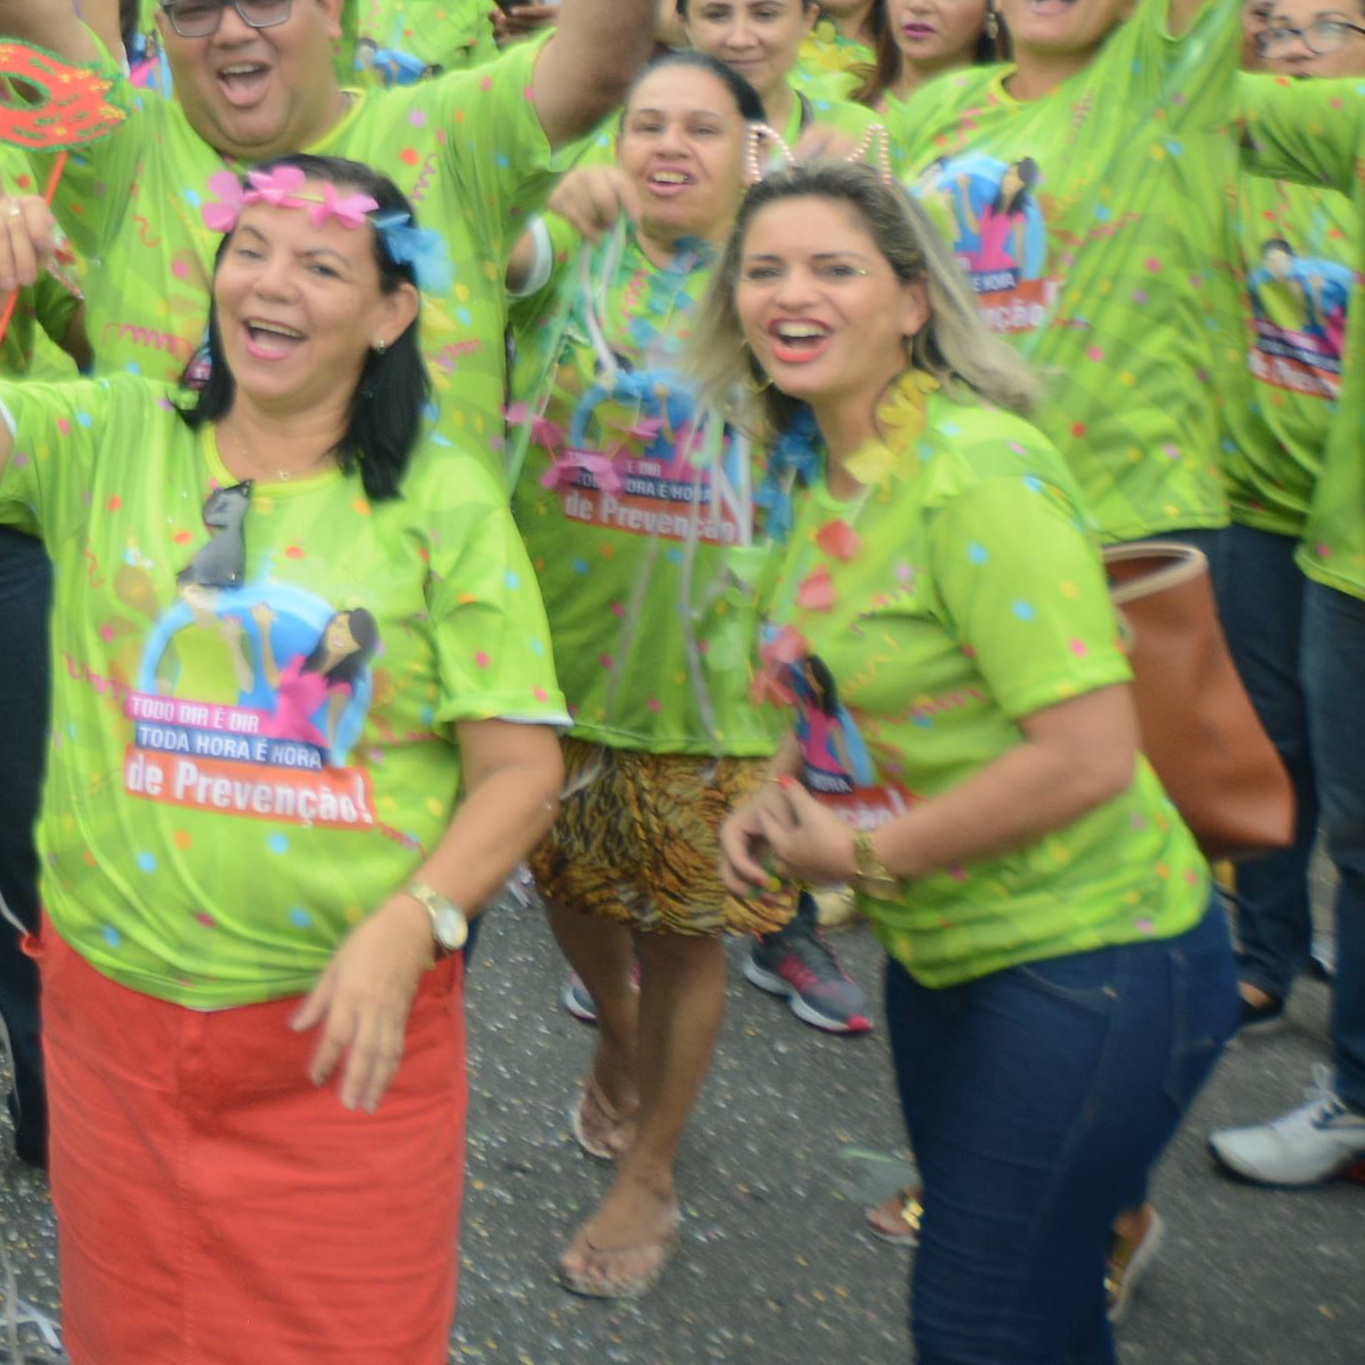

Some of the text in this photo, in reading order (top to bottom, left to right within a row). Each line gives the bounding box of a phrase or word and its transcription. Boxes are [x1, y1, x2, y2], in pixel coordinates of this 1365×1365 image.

[564, 490, 593, 520] de
[132, 697, 175, 721] TODO
[139, 725, 323, 770] TODA HORA É HORA
[128, 753, 374, 828] de Prevenção!
